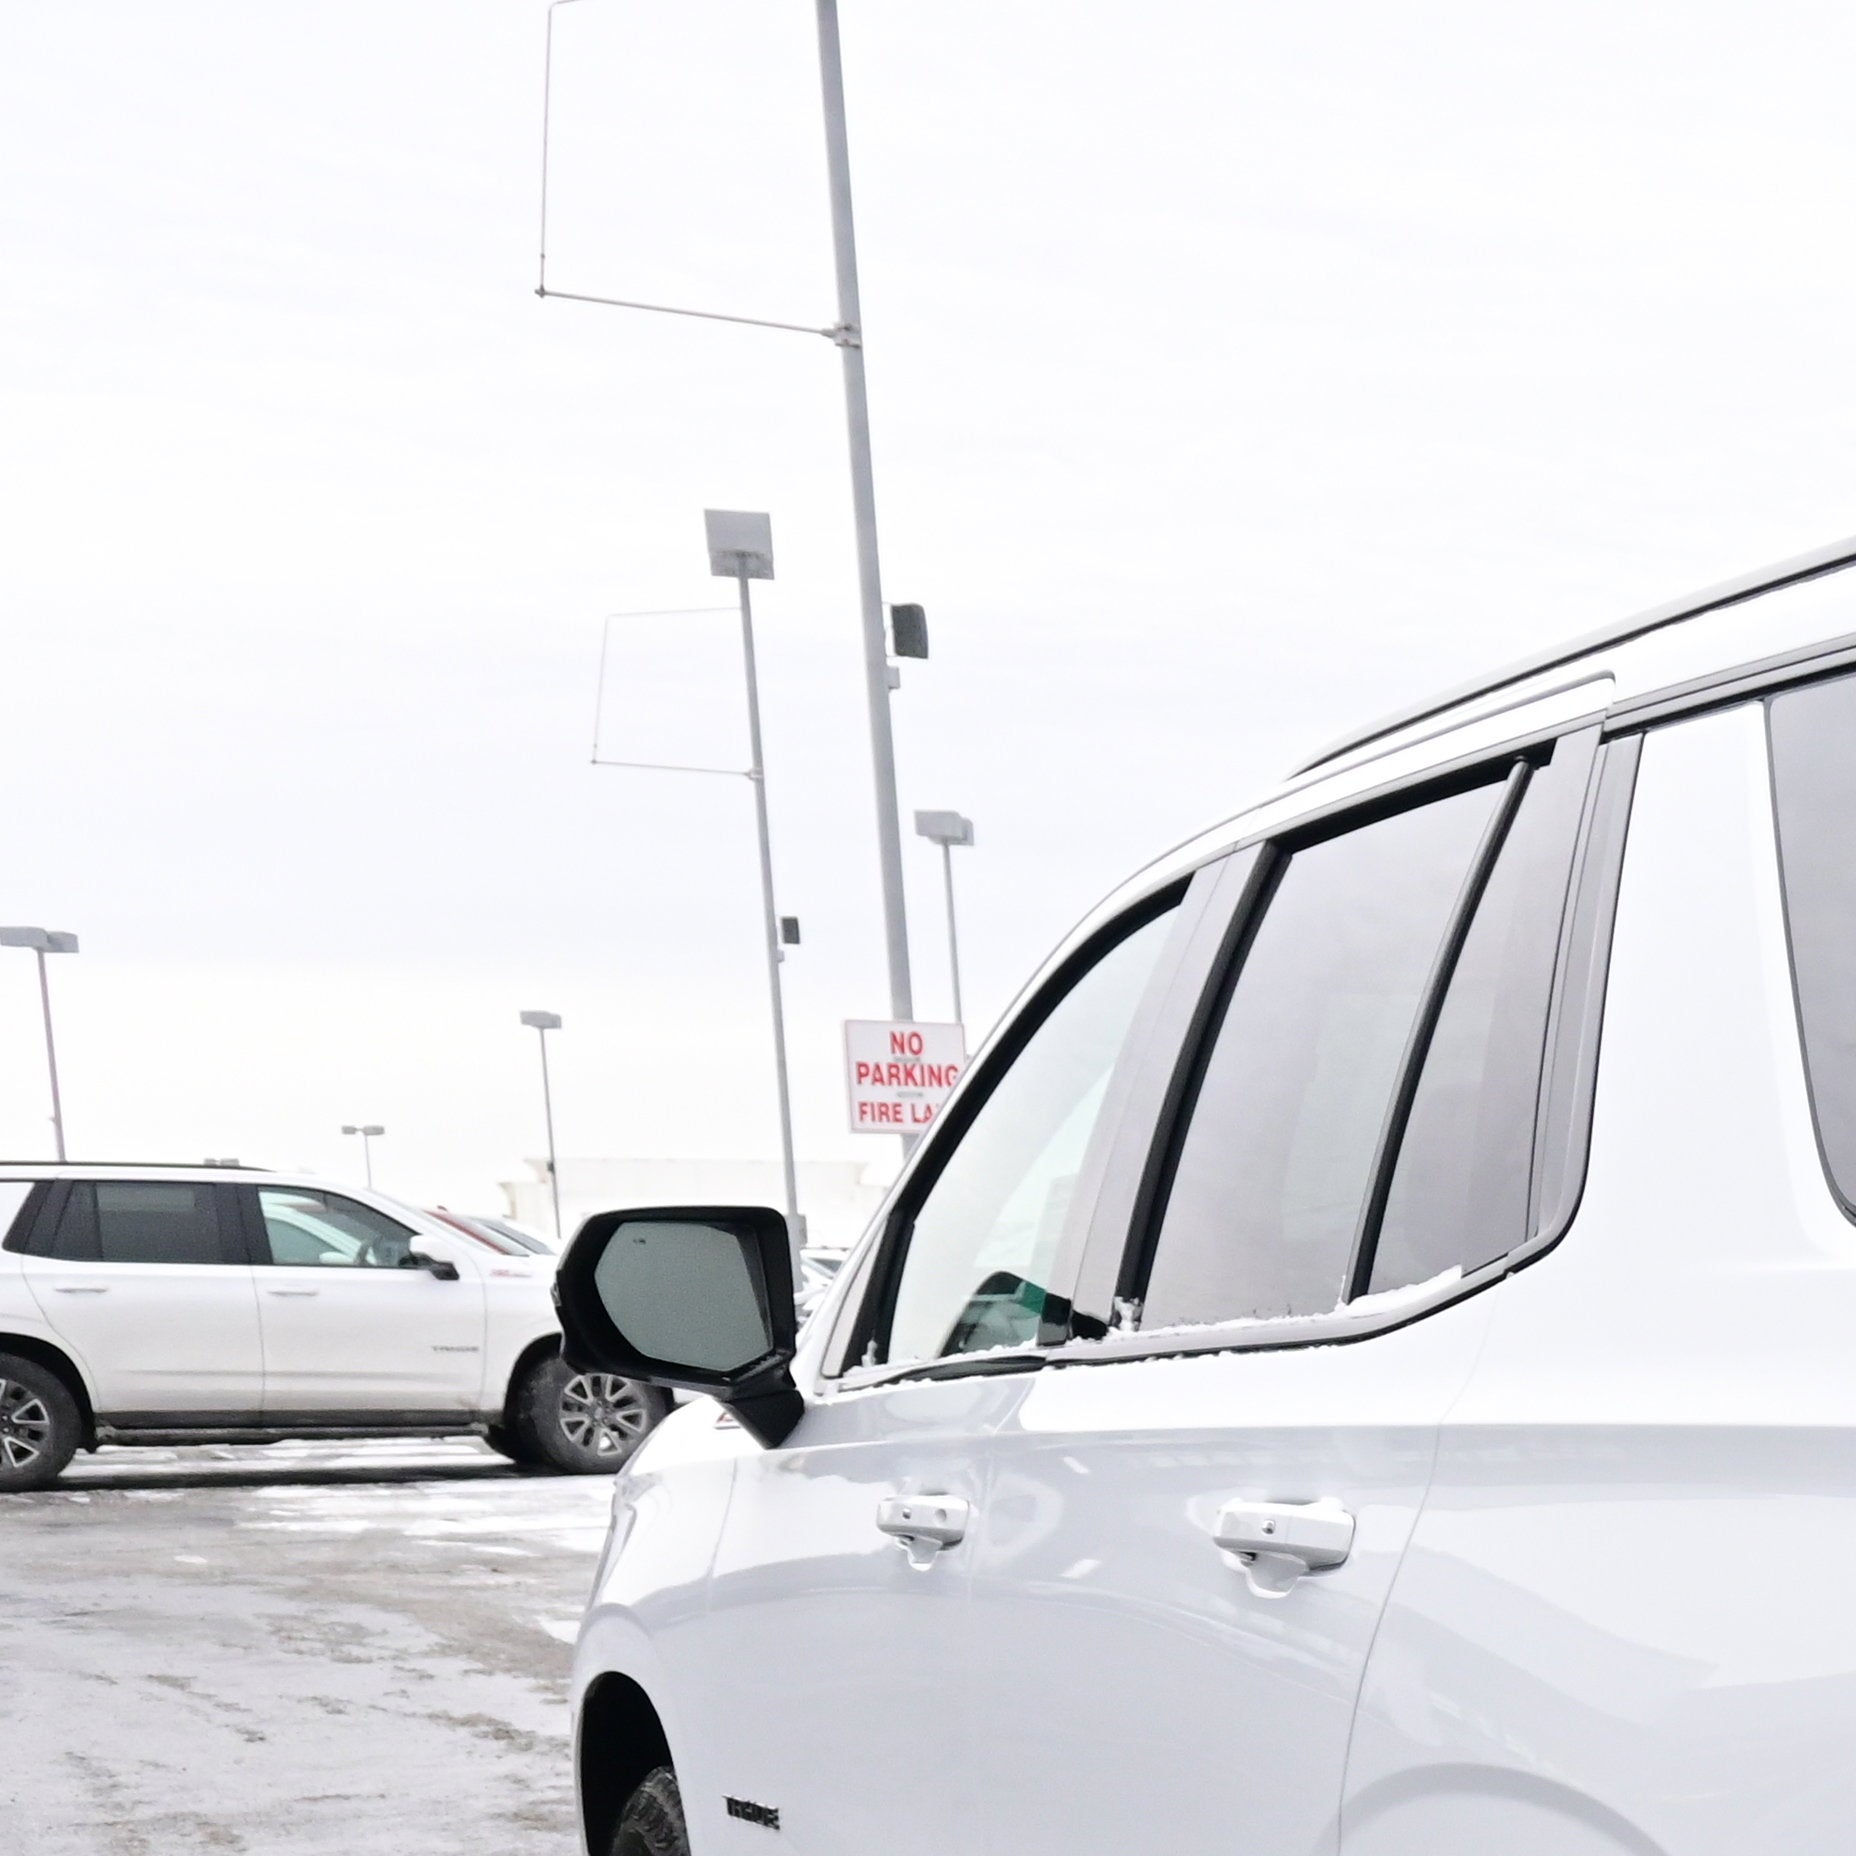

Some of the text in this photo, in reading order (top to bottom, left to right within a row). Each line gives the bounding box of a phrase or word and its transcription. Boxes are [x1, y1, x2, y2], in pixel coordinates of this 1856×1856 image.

[889, 1030, 923, 1055] NO
[855, 1061, 959, 1088] PARKING
[857, 1101, 937, 1124] FIRE LA
